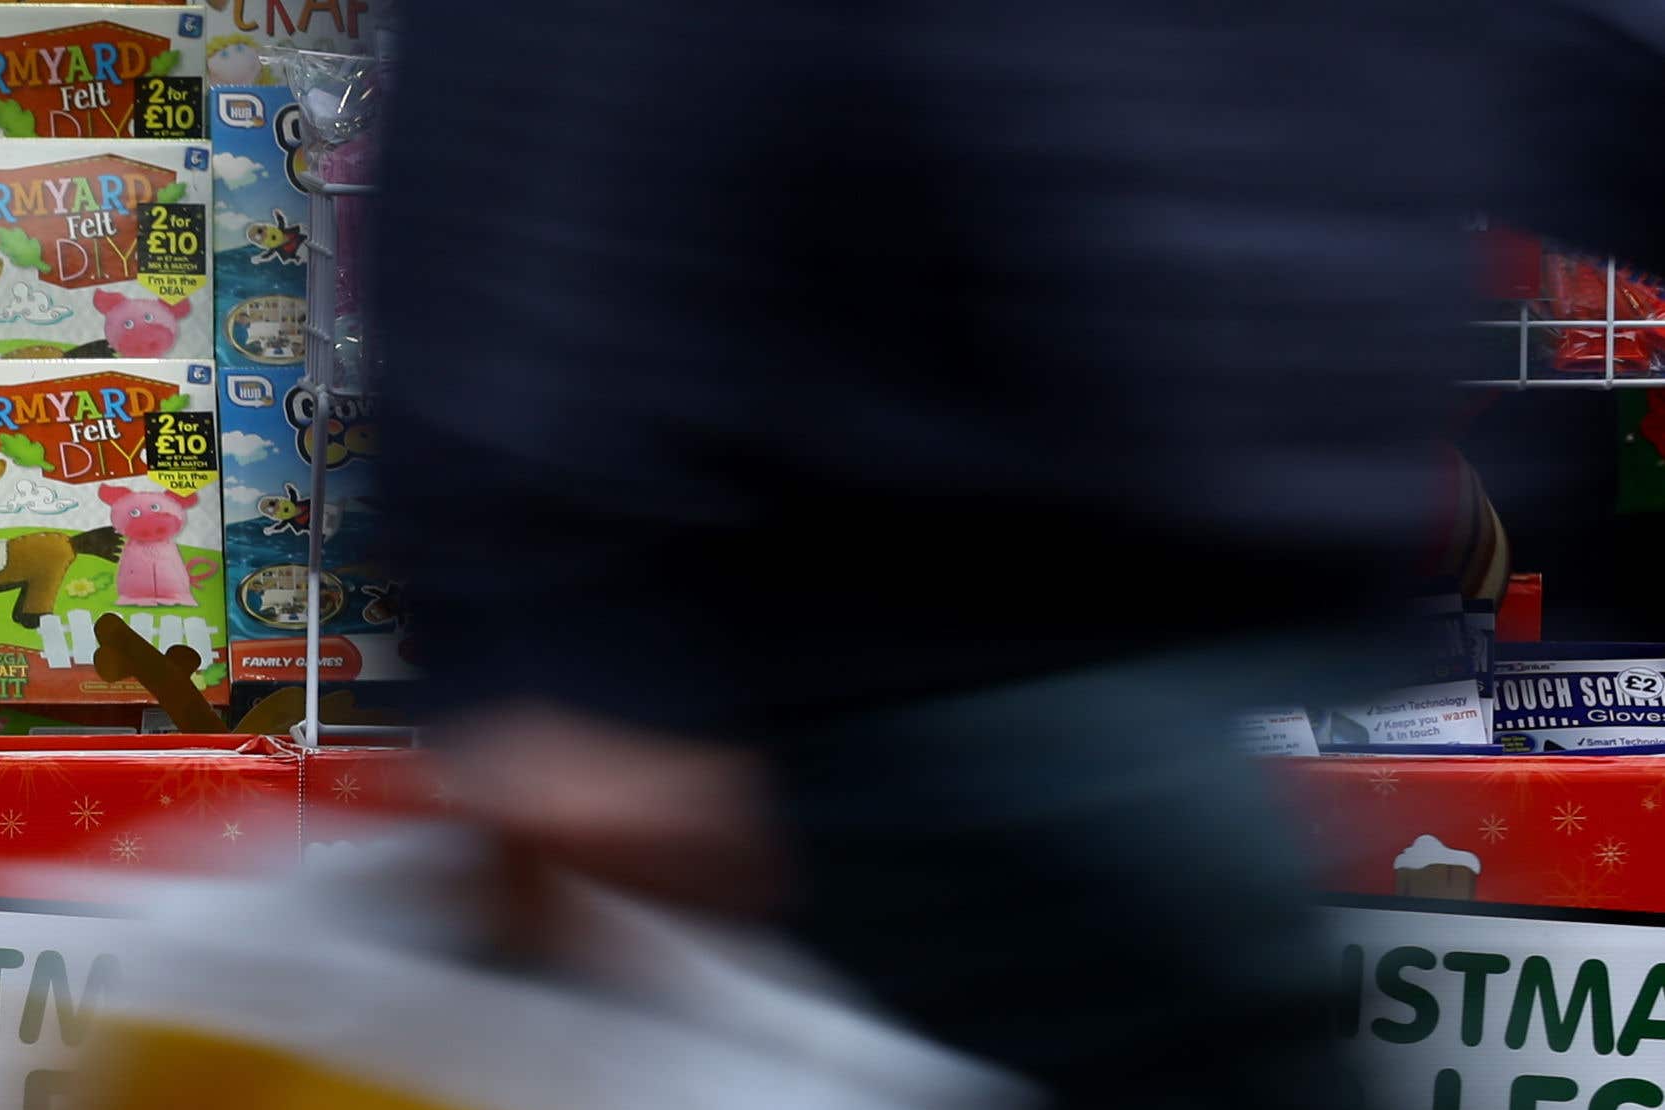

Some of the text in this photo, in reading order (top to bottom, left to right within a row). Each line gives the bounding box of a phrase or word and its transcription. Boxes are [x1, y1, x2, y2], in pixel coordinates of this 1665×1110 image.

[60, 82, 110, 111] Felt
[148, 79, 187, 104] 2 for
[144, 105, 195, 129] £10
[66, 210, 117, 240] Felt
[150, 205, 191, 229] 2 for
[146, 231, 198, 255] £10
[69, 417, 120, 444] Felt
[159, 413, 198, 434] 2 for
[155, 434, 207, 454] £10
[158, 471, 175, 480] I'm
[178, 471, 188, 480] in
[170, 480, 197, 490] DEAL
[242, 656, 292, 668] FAMILY
[1624, 674, 1658, 693] £2
[1409, 696, 1467, 711] Technology
[1420, 715, 1439, 728] you
[1442, 708, 1478, 722] warm
[1410, 727, 1441, 739] touch
